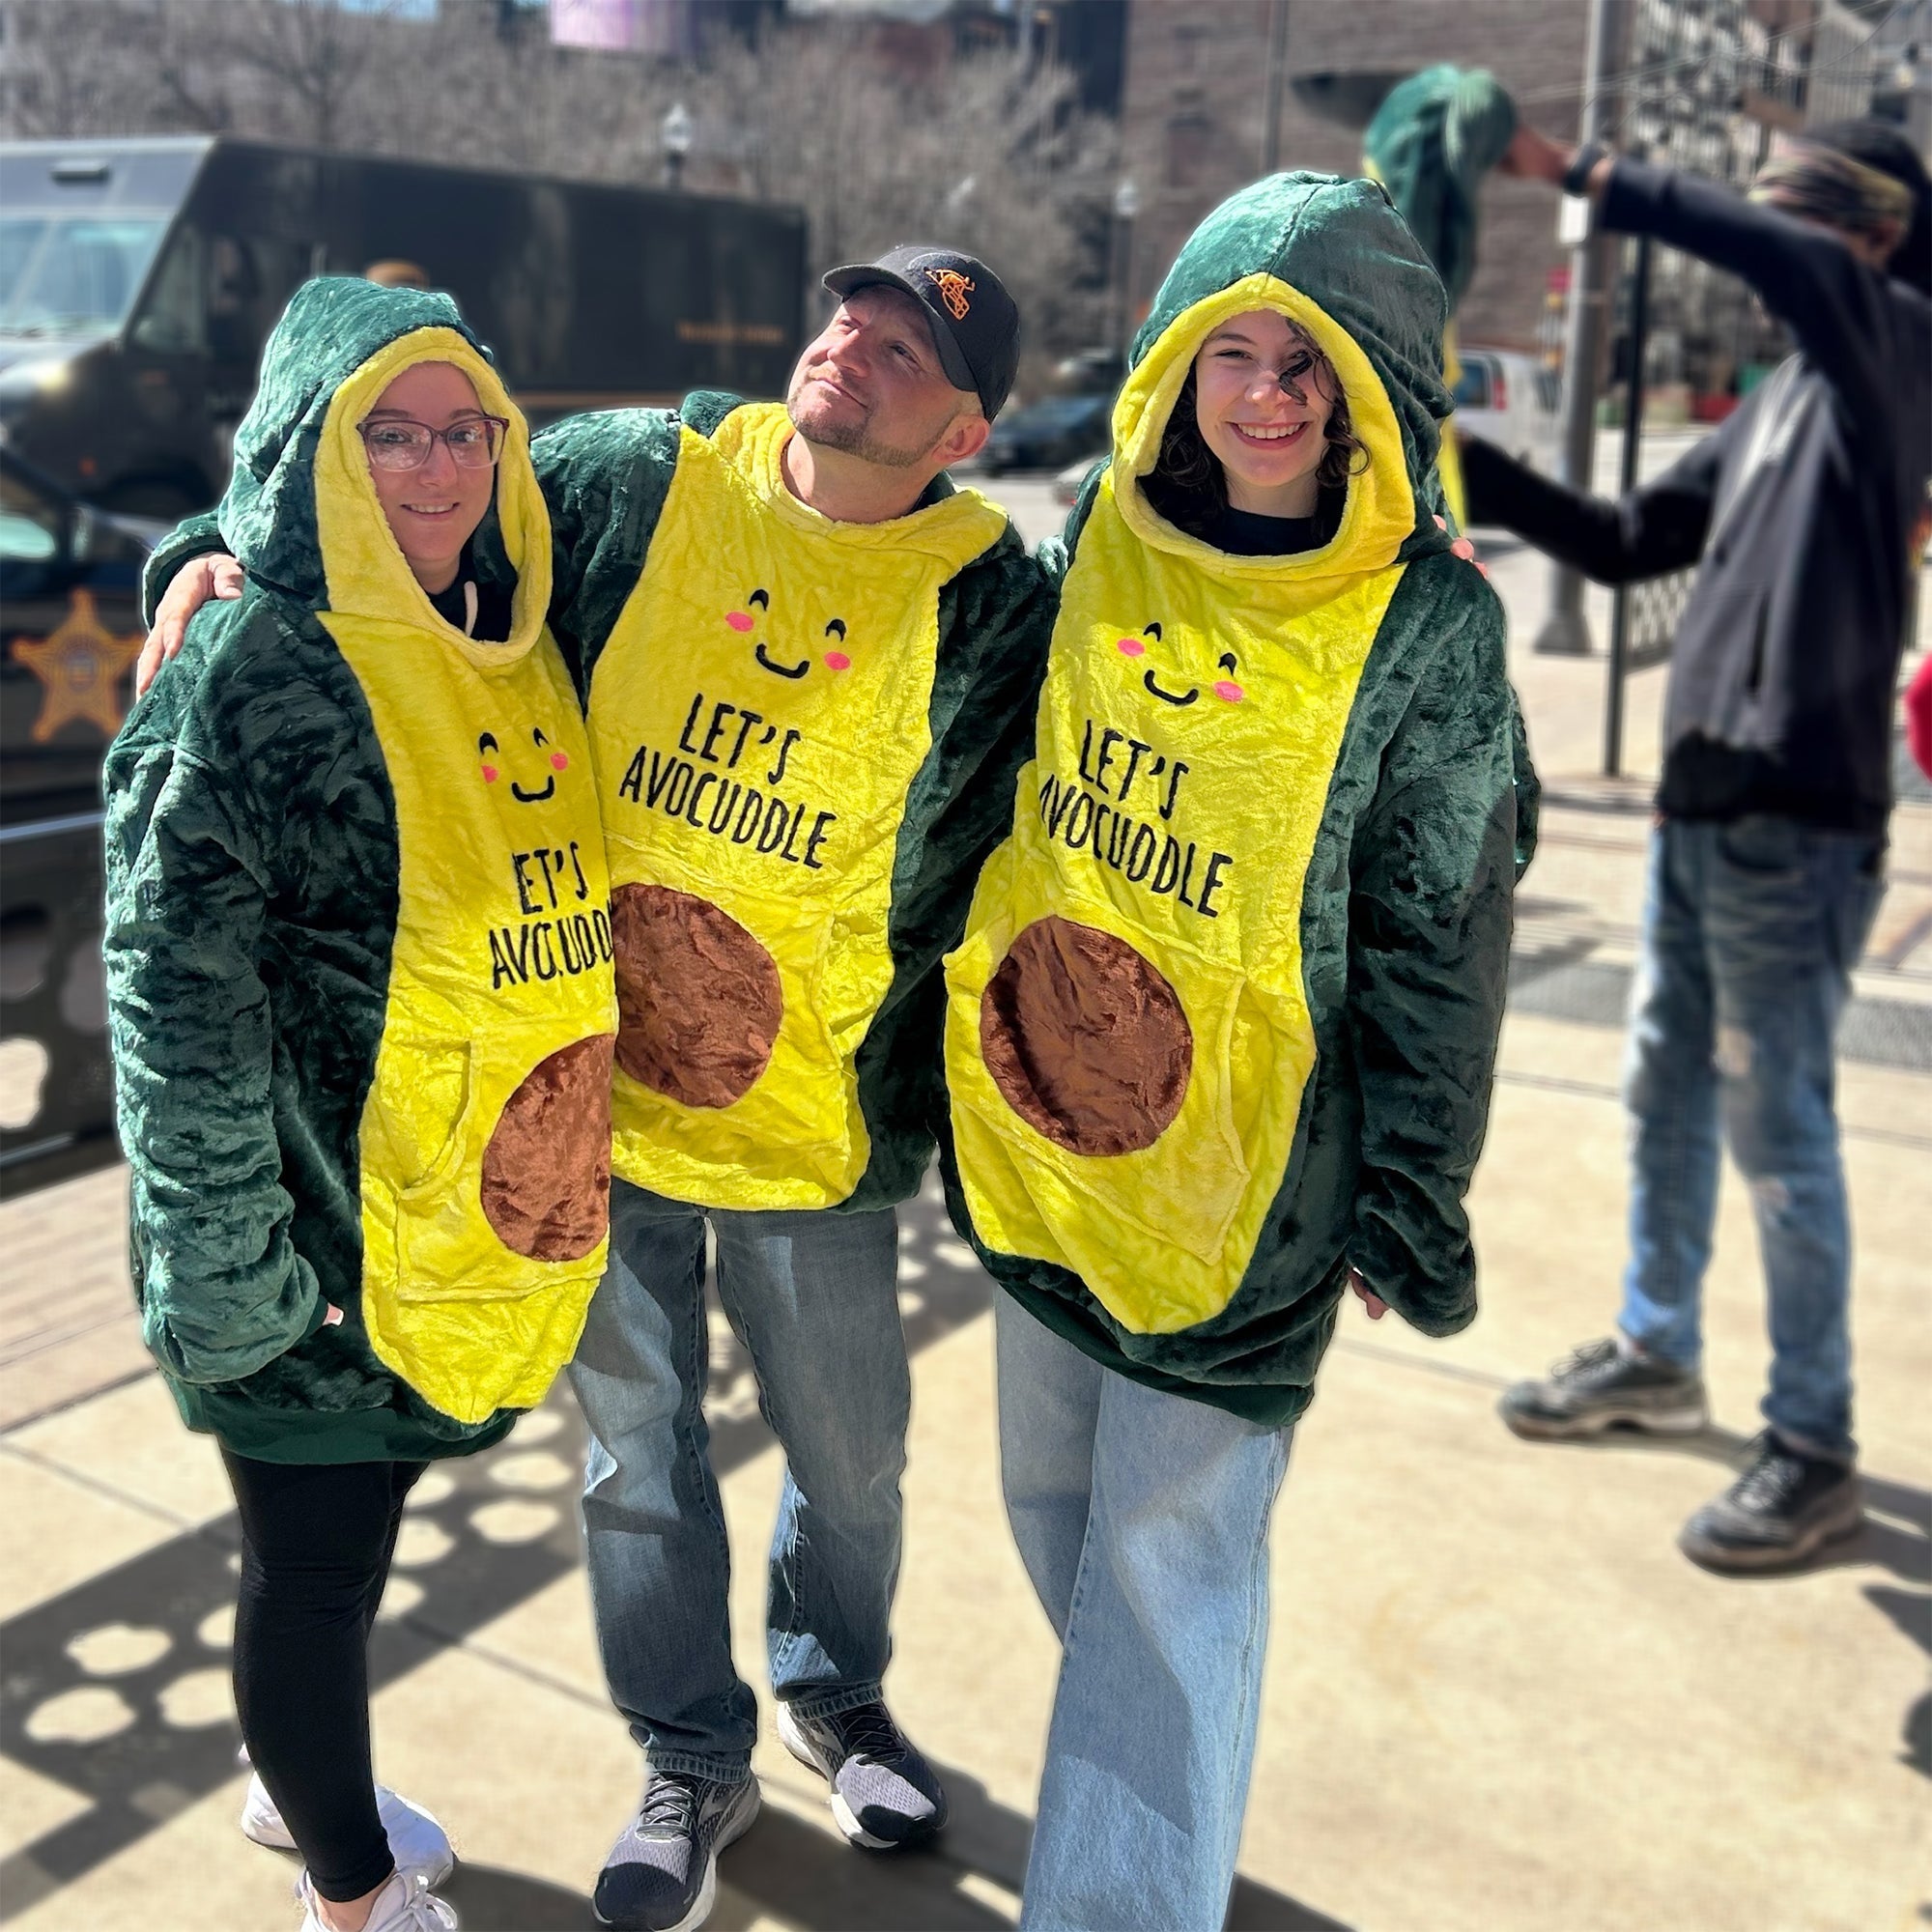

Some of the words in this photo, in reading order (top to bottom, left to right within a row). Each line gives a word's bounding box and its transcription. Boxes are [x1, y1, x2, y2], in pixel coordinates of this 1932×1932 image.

[678, 693, 801, 785] LET'S
[1078, 719, 1189, 820] LET'S
[618, 745, 837, 869] AVOCUDDLE
[512, 840, 589, 915] ET'S
